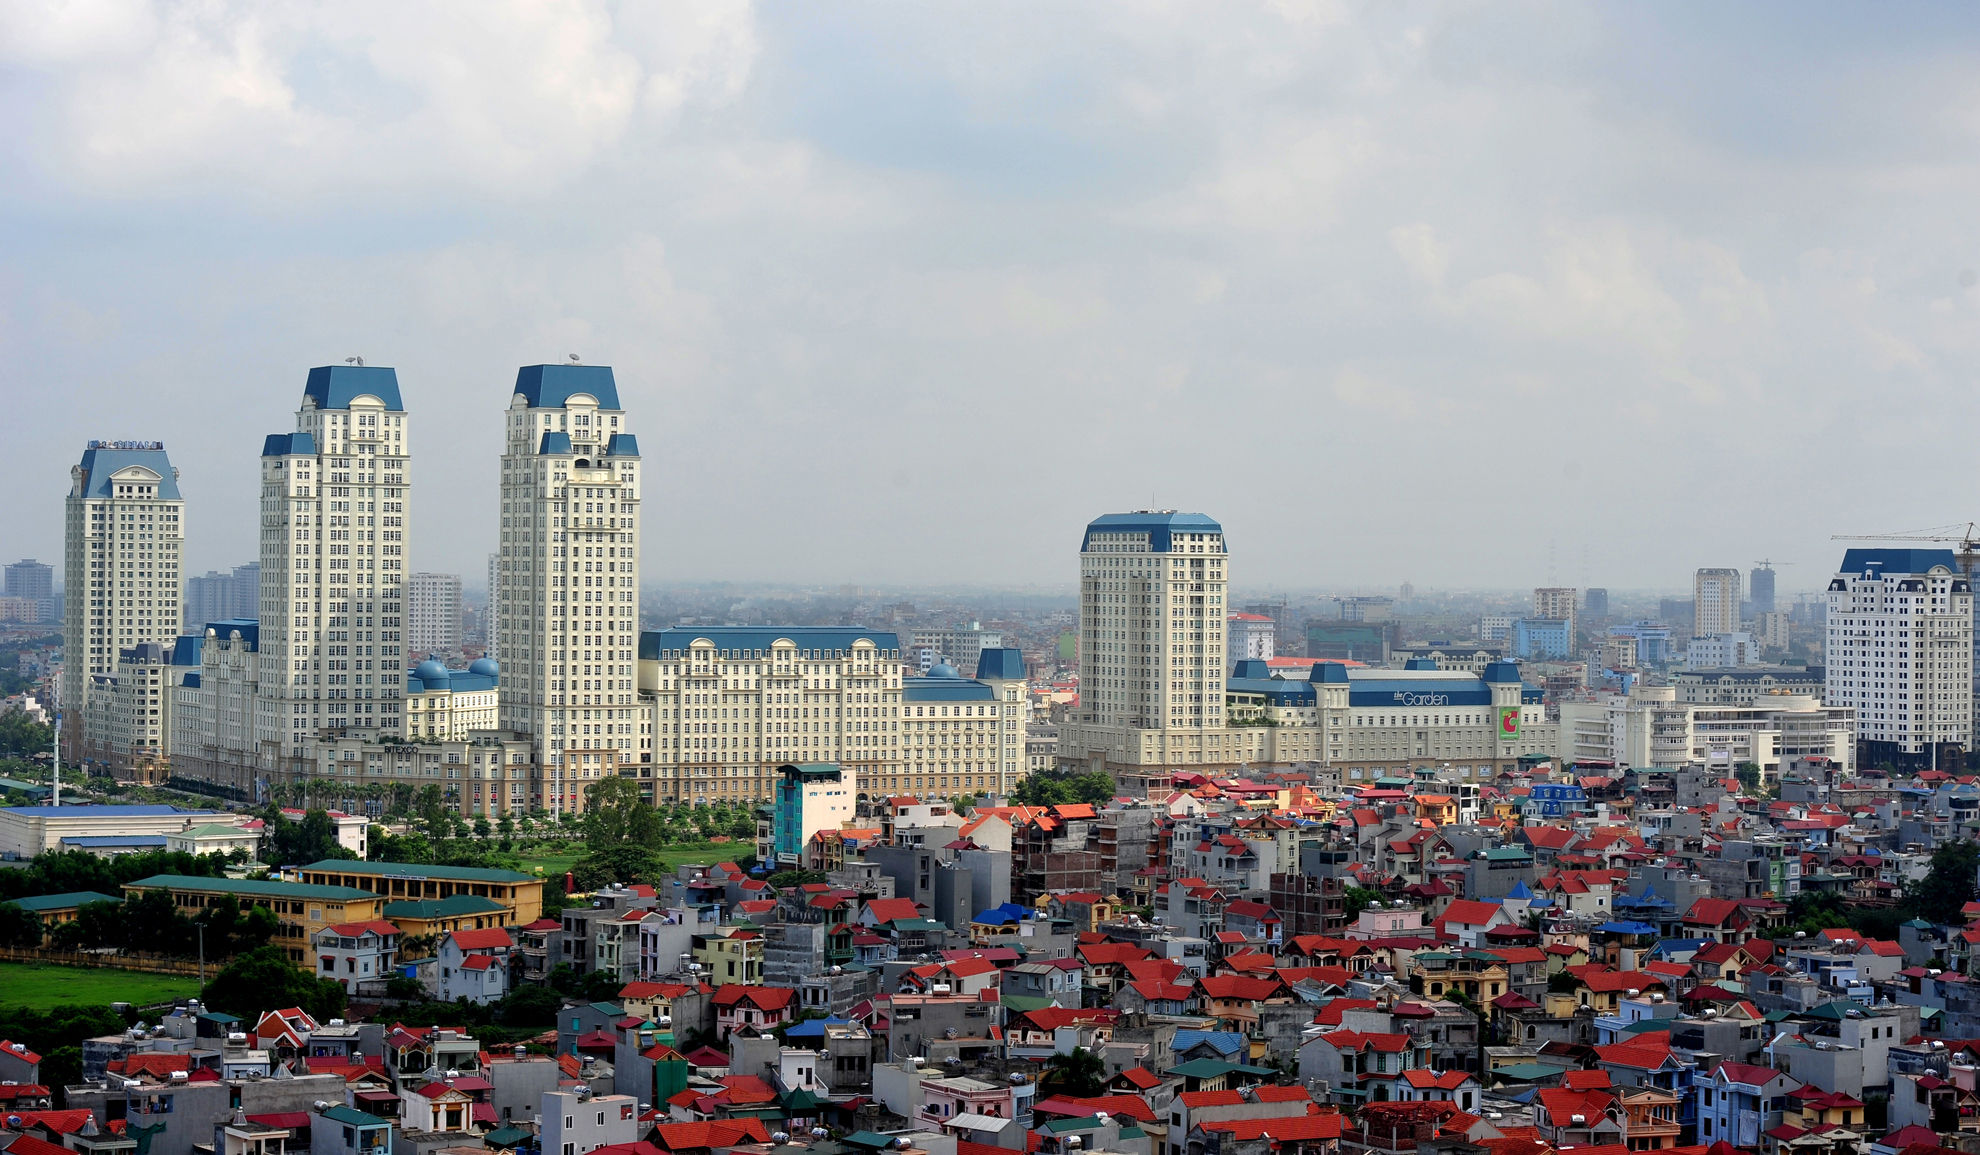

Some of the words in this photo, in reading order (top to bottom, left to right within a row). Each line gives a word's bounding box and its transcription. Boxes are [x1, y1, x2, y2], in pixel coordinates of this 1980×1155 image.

[1403, 691, 1449, 706] Garden
[1503, 710, 1519, 733] C
[384, 746, 419, 754] BITEXCO
